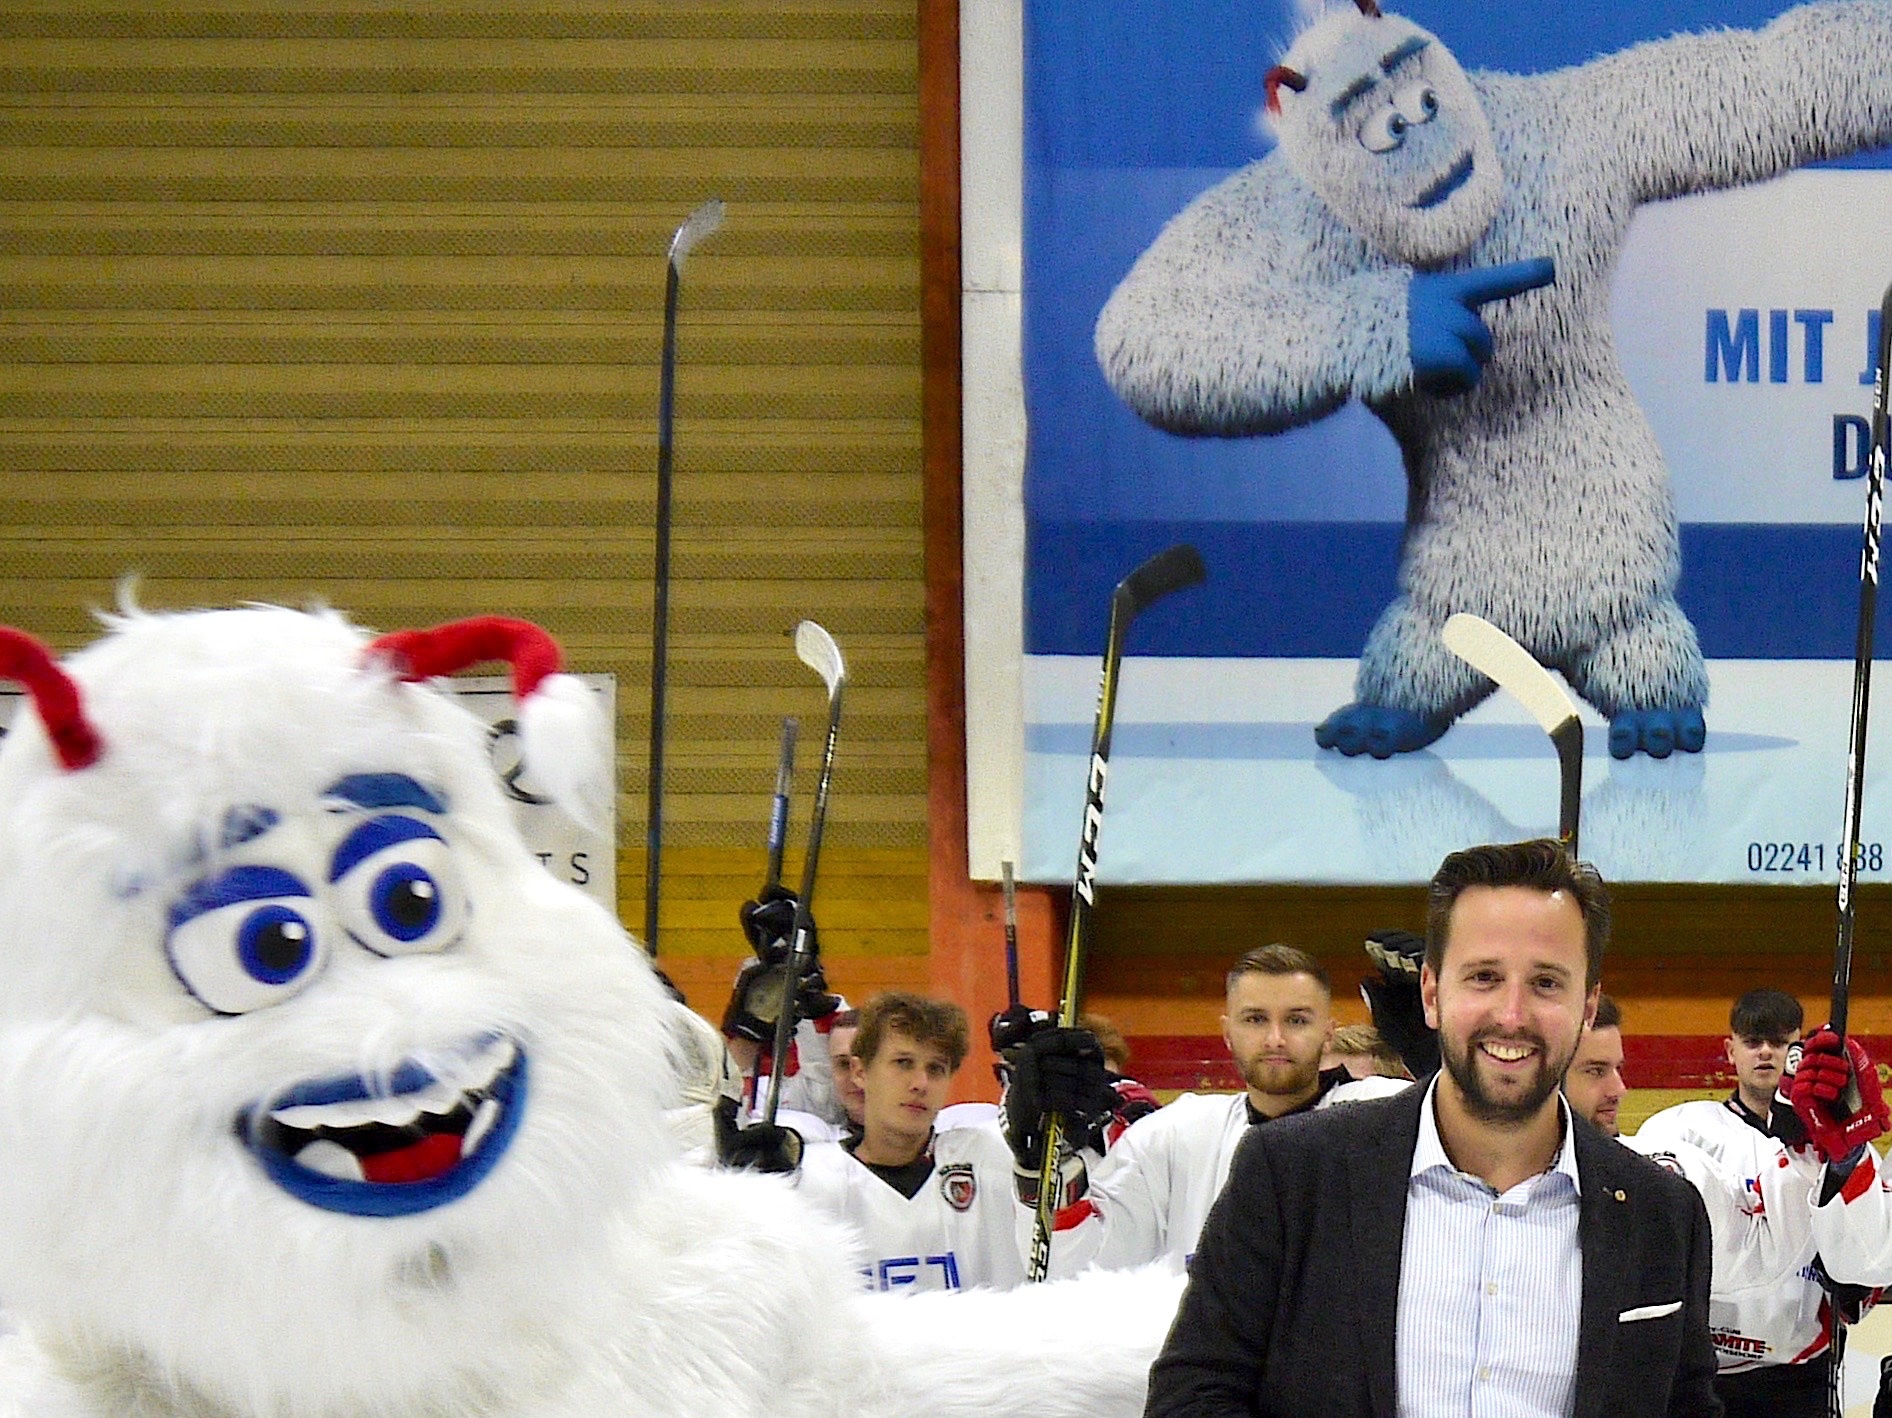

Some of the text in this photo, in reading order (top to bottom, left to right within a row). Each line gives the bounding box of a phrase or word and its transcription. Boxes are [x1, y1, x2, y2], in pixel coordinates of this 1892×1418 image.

[1705, 308, 1834, 383] MIT
[1077, 752, 1107, 906] CCM
[1748, 842, 1825, 872] 02241
